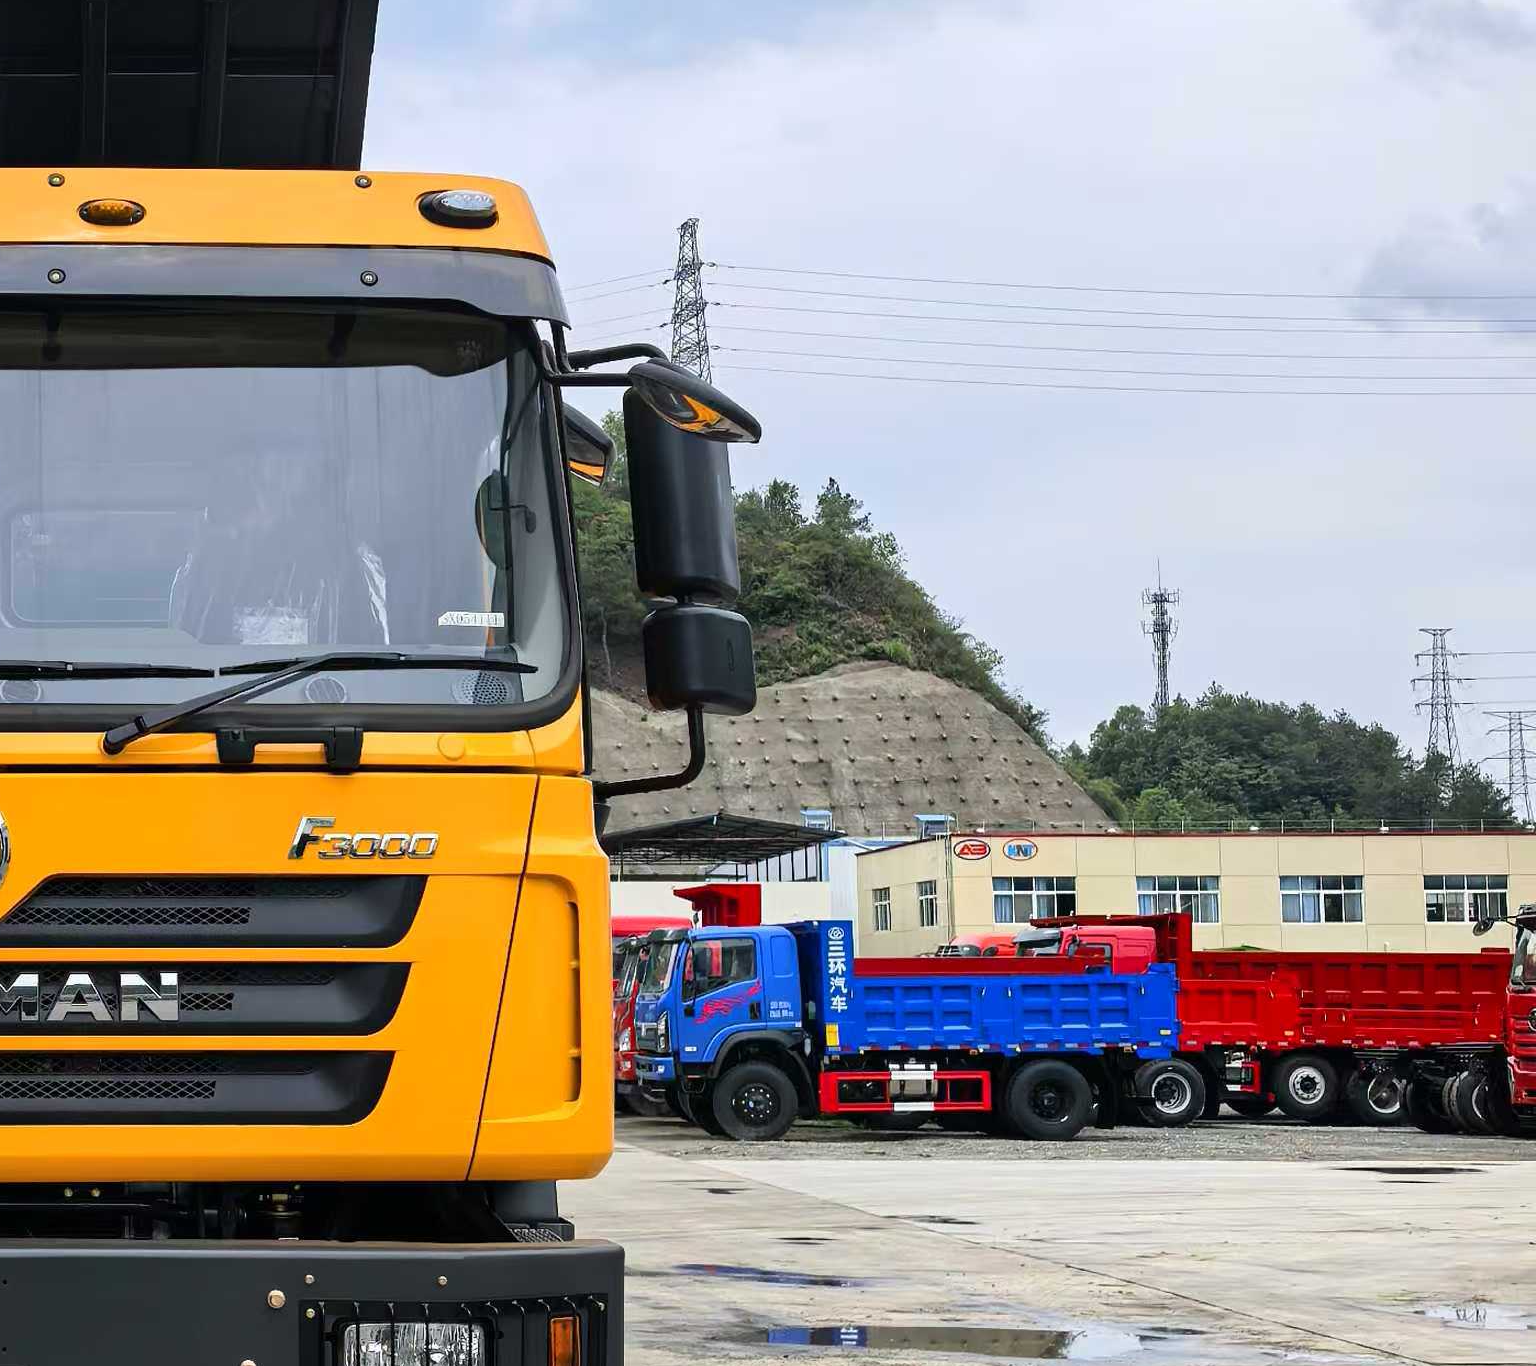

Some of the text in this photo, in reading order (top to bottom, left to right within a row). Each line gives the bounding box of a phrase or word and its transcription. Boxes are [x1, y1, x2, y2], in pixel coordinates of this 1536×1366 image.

[288, 816, 439, 859] F3000
[828, 940, 848, 1013] 三环汽车
